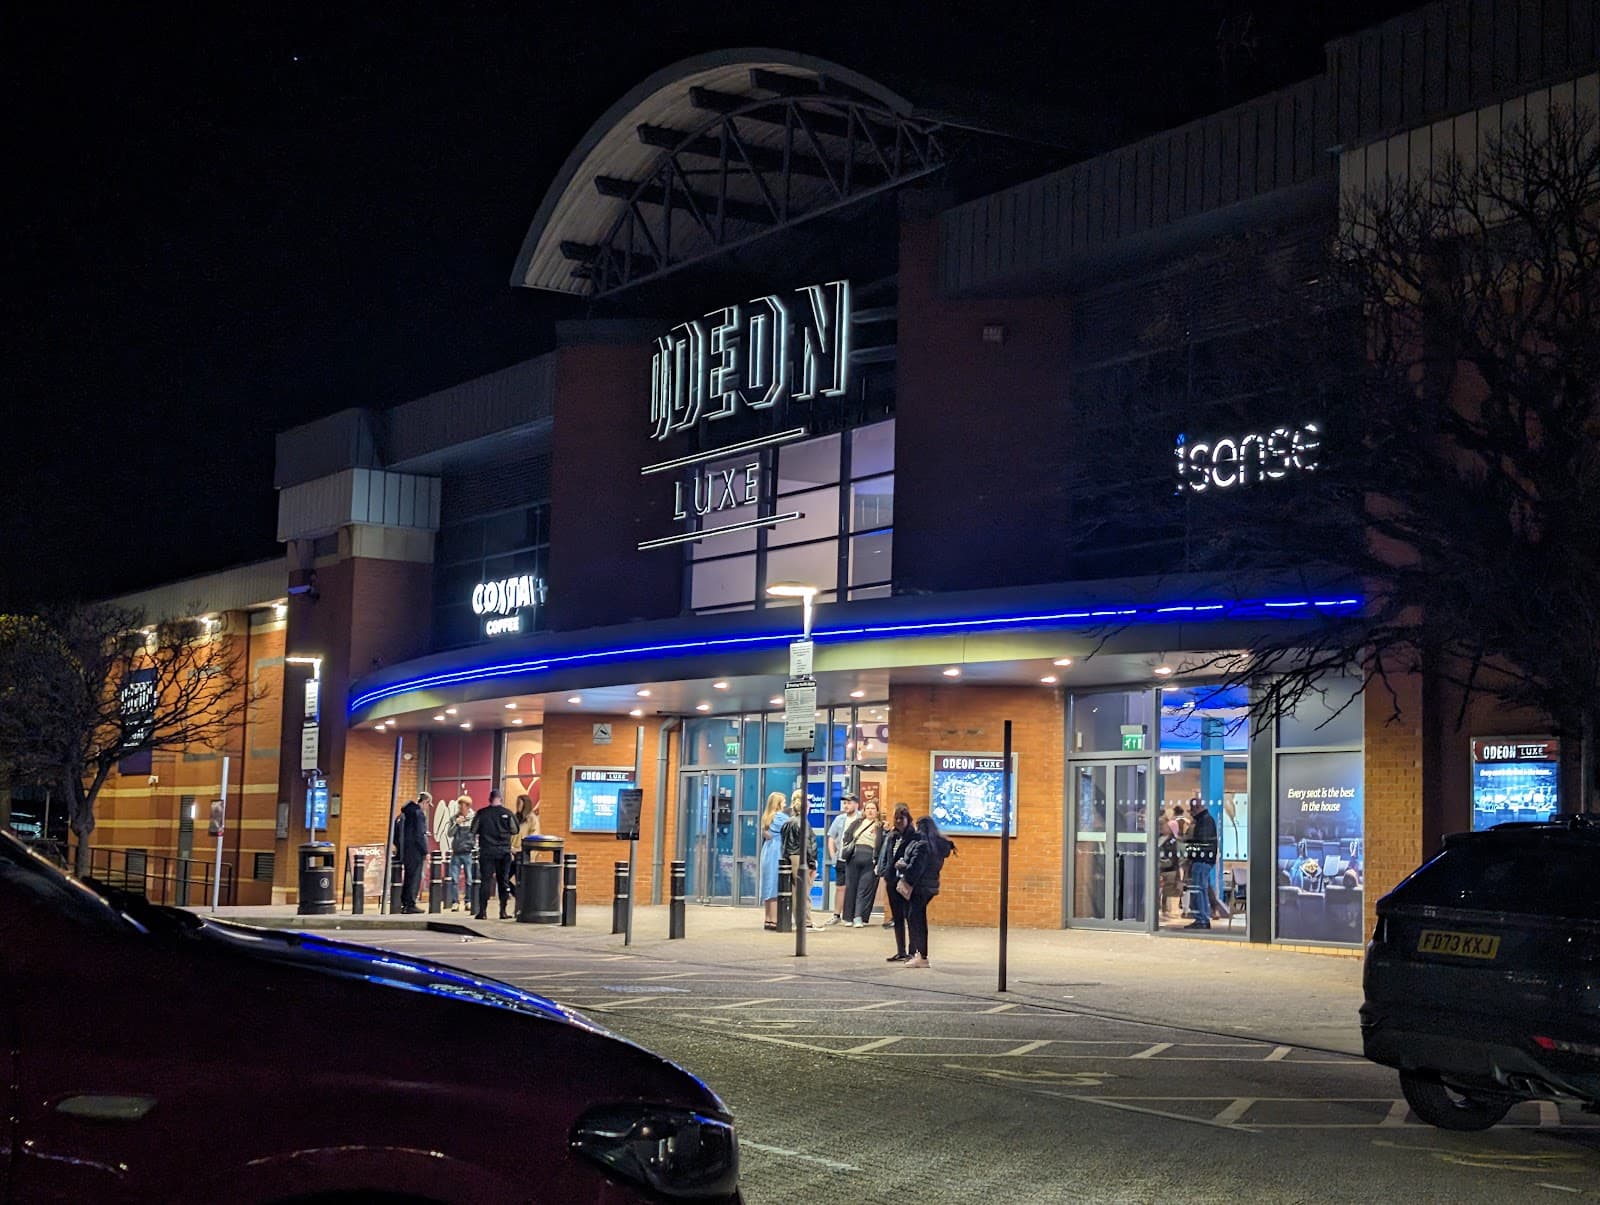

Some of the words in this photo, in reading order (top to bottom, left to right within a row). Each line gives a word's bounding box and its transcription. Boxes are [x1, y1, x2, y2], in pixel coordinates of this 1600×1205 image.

[649, 279, 850, 441] ODEON
[673, 462, 760, 520] LUXE
[472, 575, 535, 615] COSTA
[486, 616, 520, 635] COFFEE
[1483, 745, 1517, 760] ODEON
[1521, 747, 1544, 755] LUXE
[942, 758, 975, 769] ODEON
[581, 771, 606, 781] ODEON
[1287, 788, 1306, 800] Every
[1306, 788, 1321, 798] seat
[1321, 787, 1328, 798] is
[1328, 787, 1340, 798] the
[1340, 787, 1355, 798] best
[1301, 801, 1308, 812] in
[1309, 801, 1320, 812] the
[1320, 801, 1341, 812] house
[1423, 933, 1460, 952] FD73
[1461, 936, 1494, 955] KXJ
